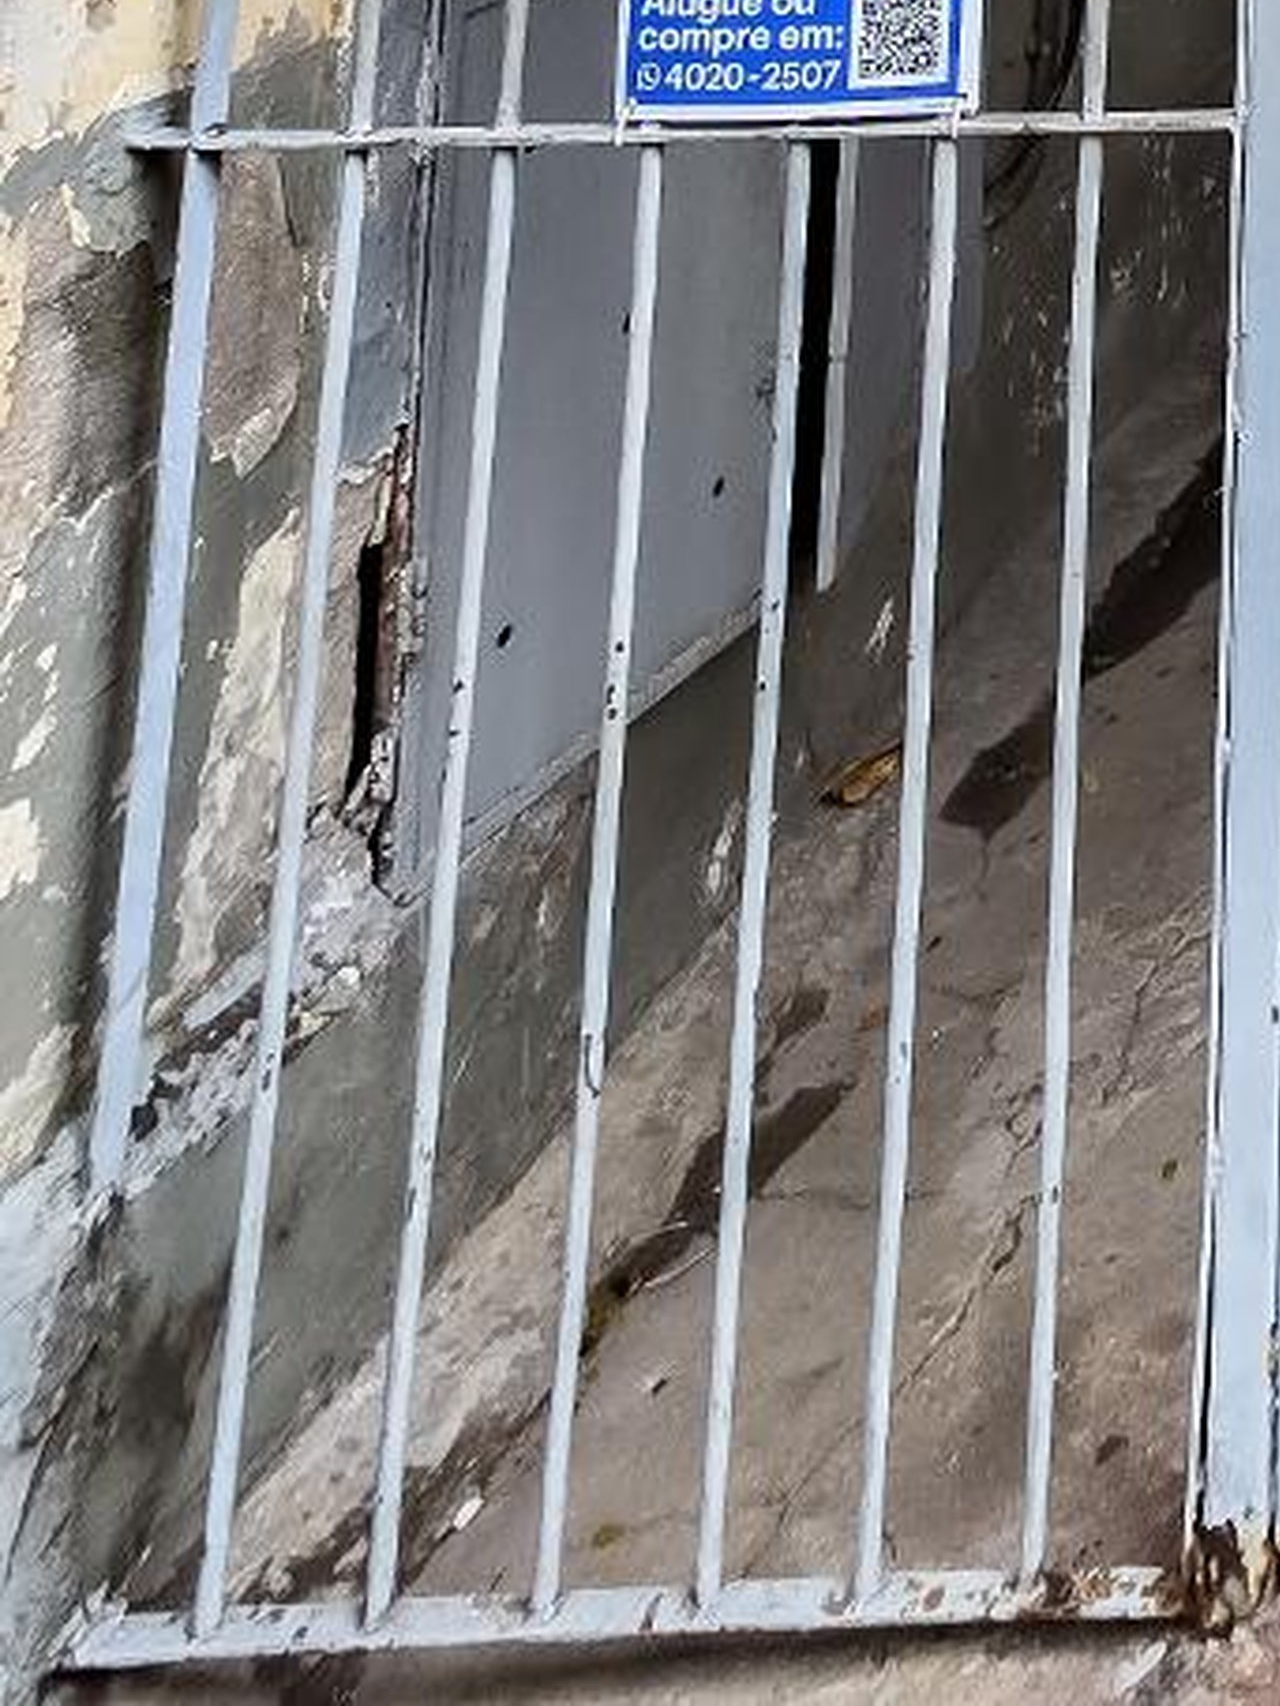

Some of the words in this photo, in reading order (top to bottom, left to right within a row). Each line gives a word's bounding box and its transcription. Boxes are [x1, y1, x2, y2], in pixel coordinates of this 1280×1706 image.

[637, 24, 770, 58] compre
[778, 23, 846, 51] em:
[664, 59, 843, 90] 4020-2507
